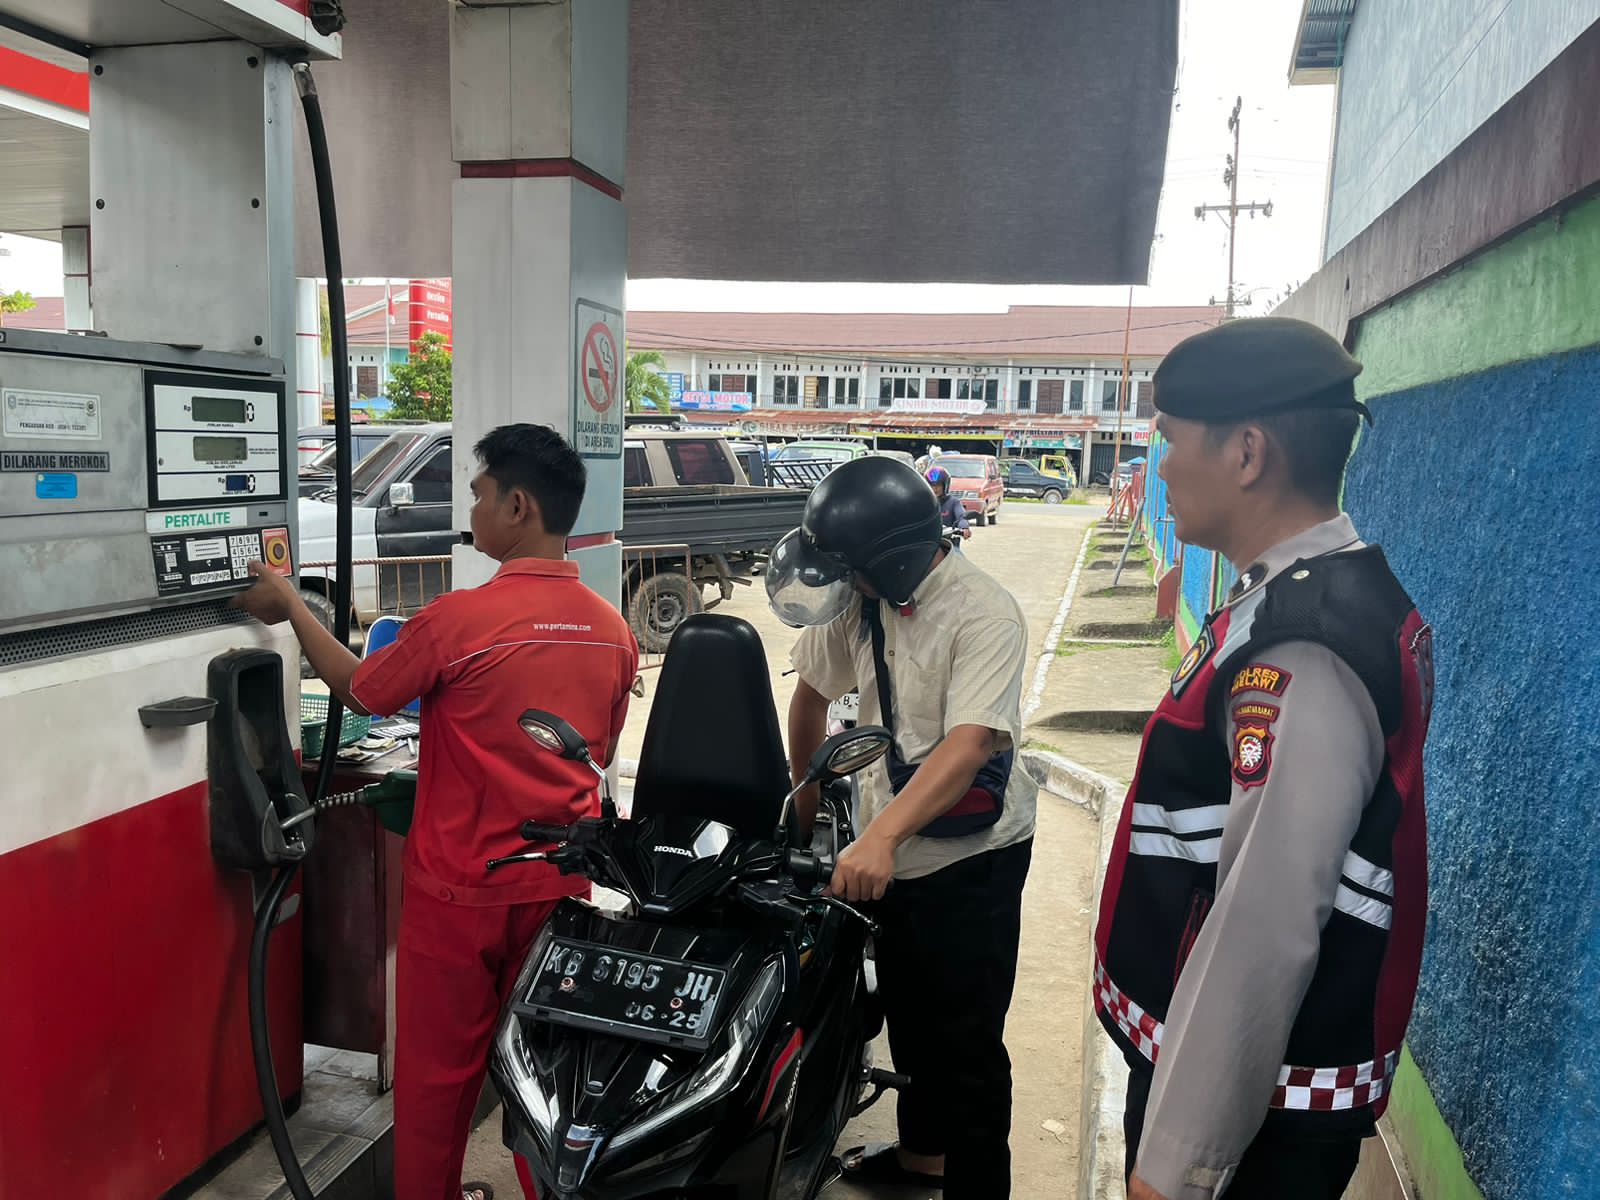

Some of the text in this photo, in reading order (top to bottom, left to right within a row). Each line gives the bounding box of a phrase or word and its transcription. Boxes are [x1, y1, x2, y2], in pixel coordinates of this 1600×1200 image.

[577, 420, 599, 434] DILARANG
[4, 454, 107, 469] DILARANG MEROKOK
[165, 511, 231, 529] PERTALITE
[533, 623, 592, 631] www.pertamina.com
[653, 845, 694, 858] HONDA
[545, 945, 714, 1002] KB 6195 JH
